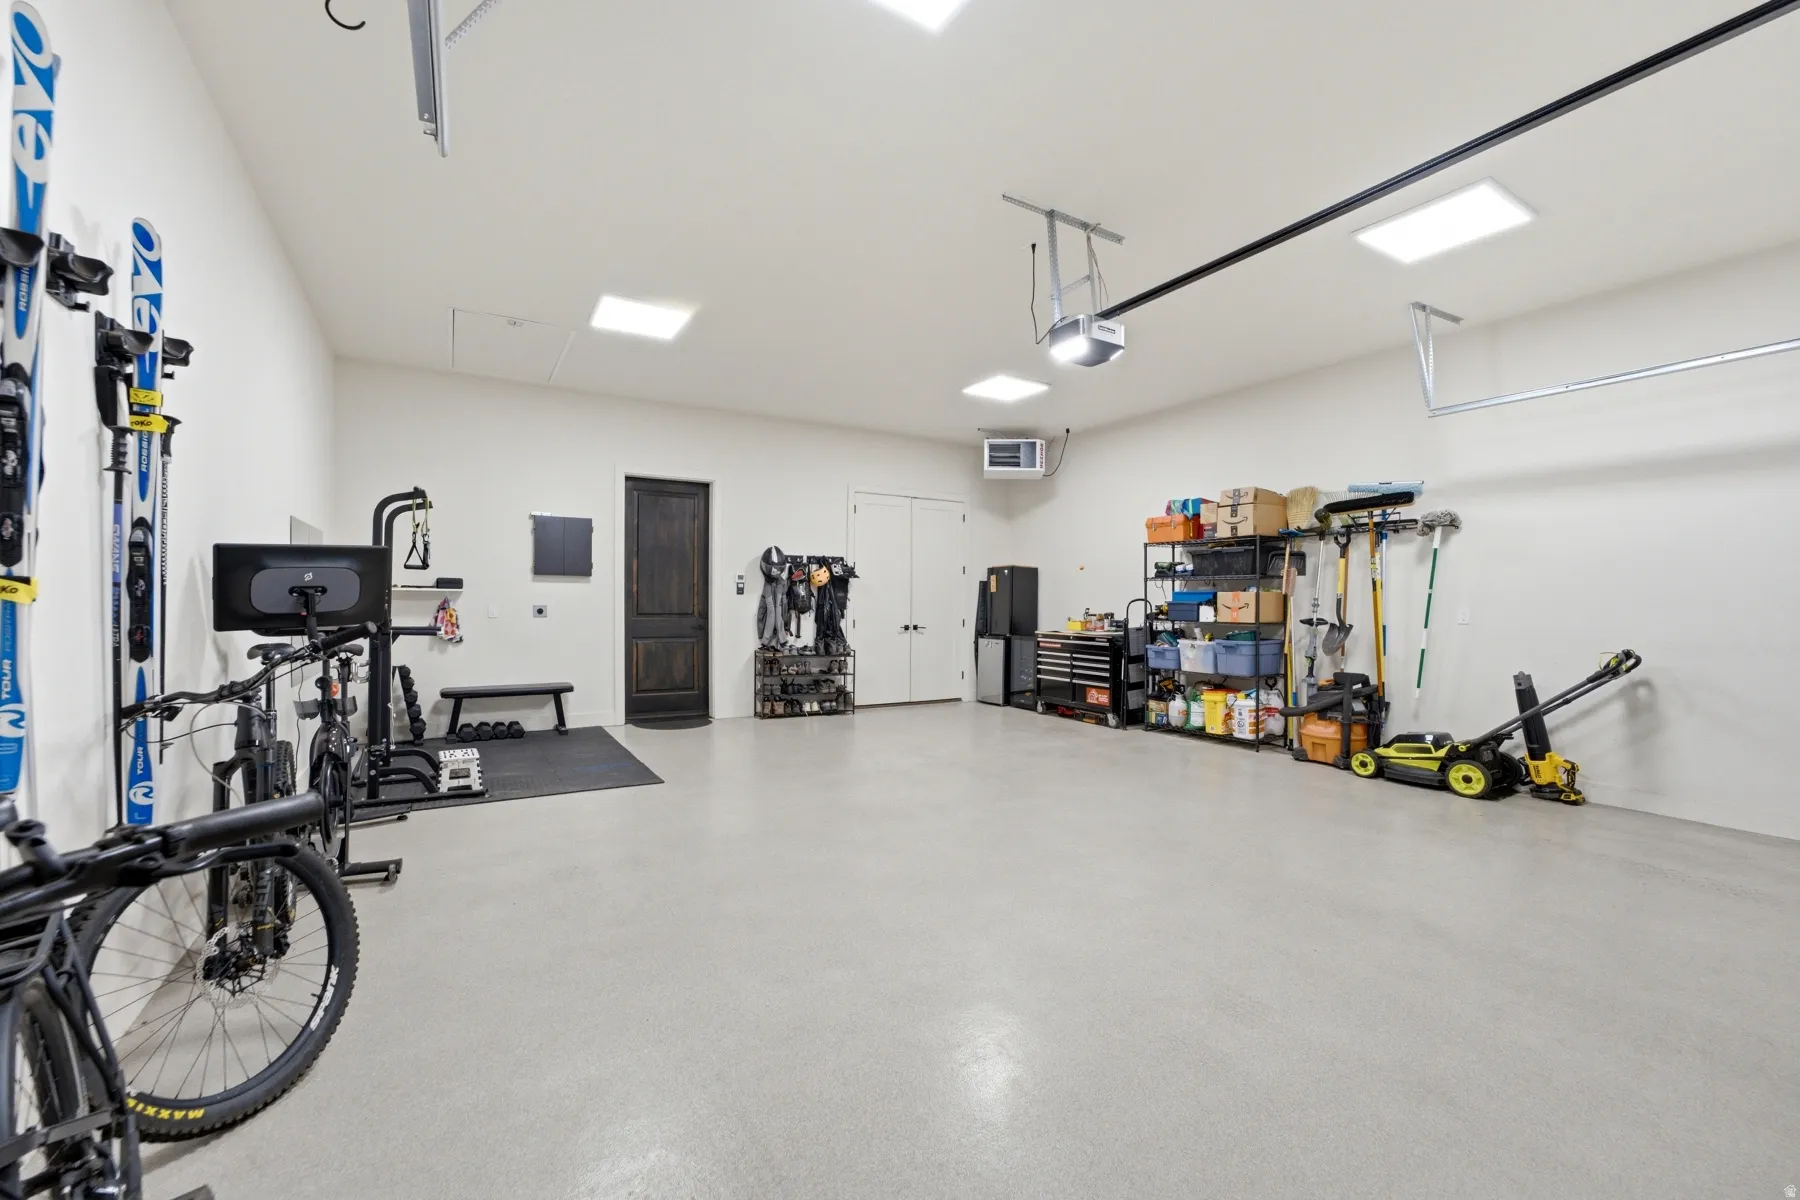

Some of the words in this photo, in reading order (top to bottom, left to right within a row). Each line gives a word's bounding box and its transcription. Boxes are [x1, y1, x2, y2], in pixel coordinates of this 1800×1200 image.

[11, 1, 55, 184] evo
[17, 267, 30, 312] ROSSI
[131, 216, 164, 353] evo
[1, 659, 13, 700] TOUR
[136, 746, 145, 775] TOUR
